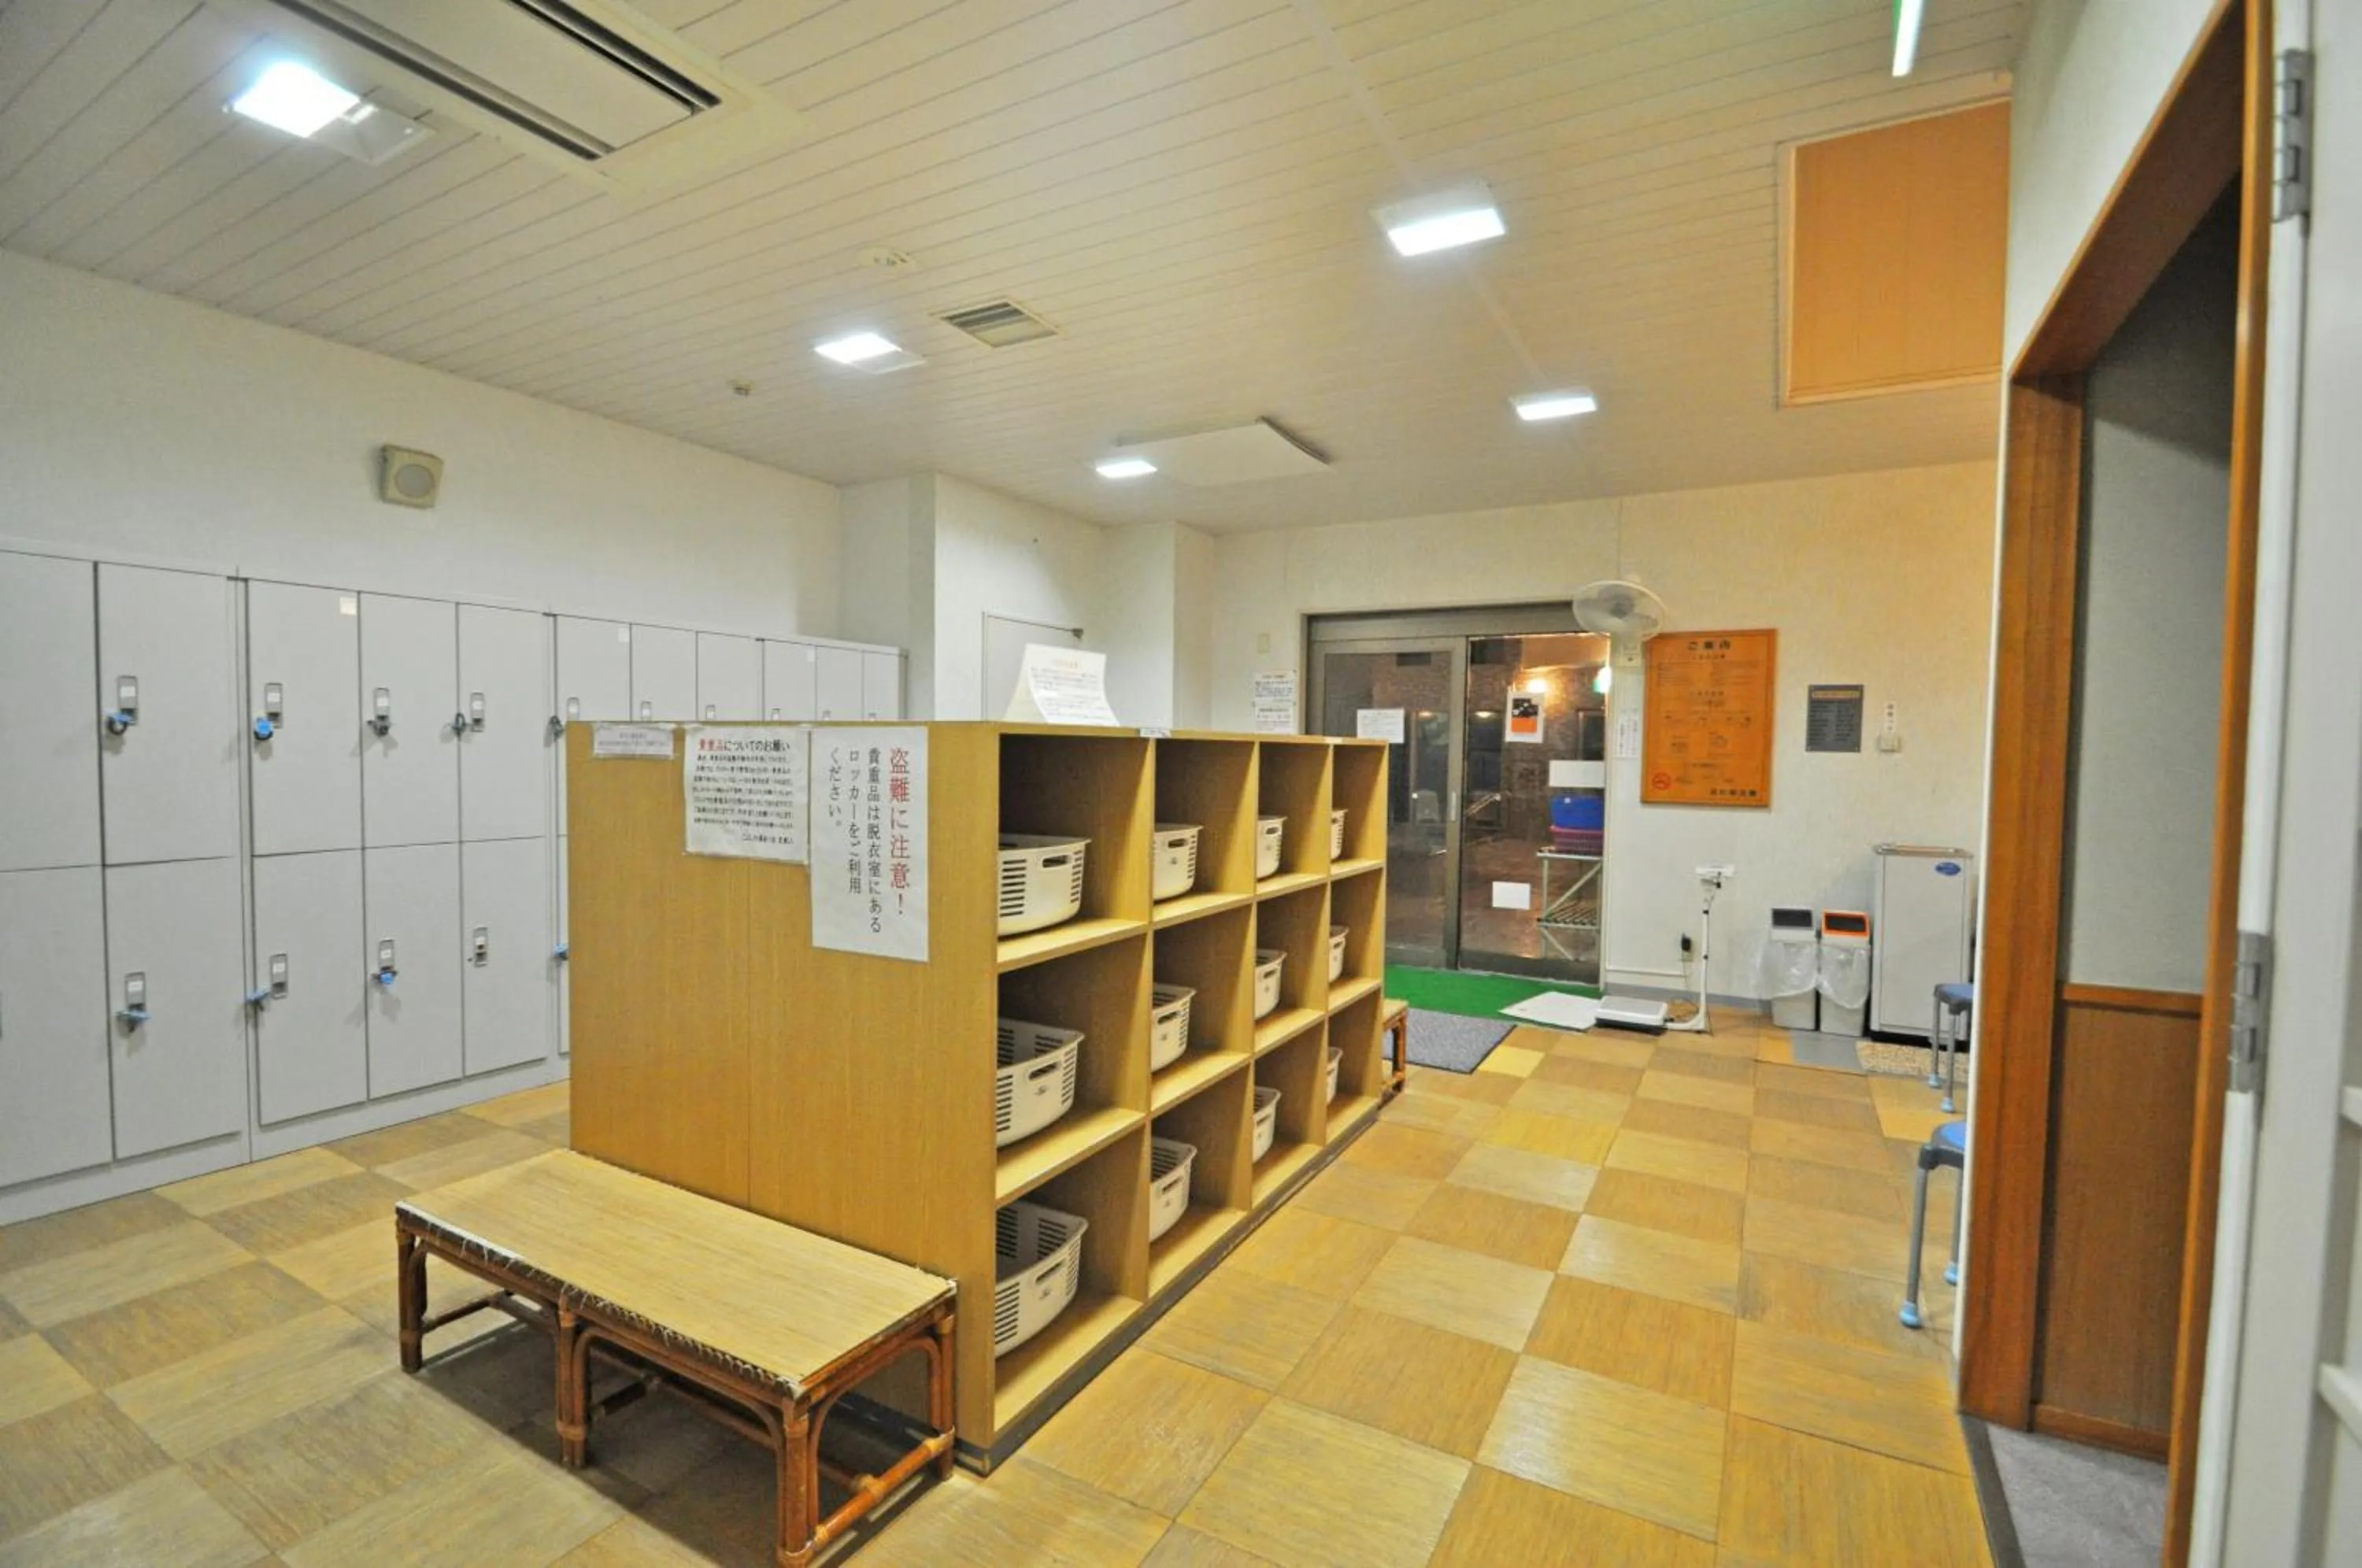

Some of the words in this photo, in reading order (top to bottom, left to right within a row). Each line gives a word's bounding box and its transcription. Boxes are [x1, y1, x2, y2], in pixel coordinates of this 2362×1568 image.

[828, 747, 842, 827] ください。
[849, 749, 861, 894] ロッカーをご利用
[867, 747, 882, 933] 貴重品は脱衣室にある
